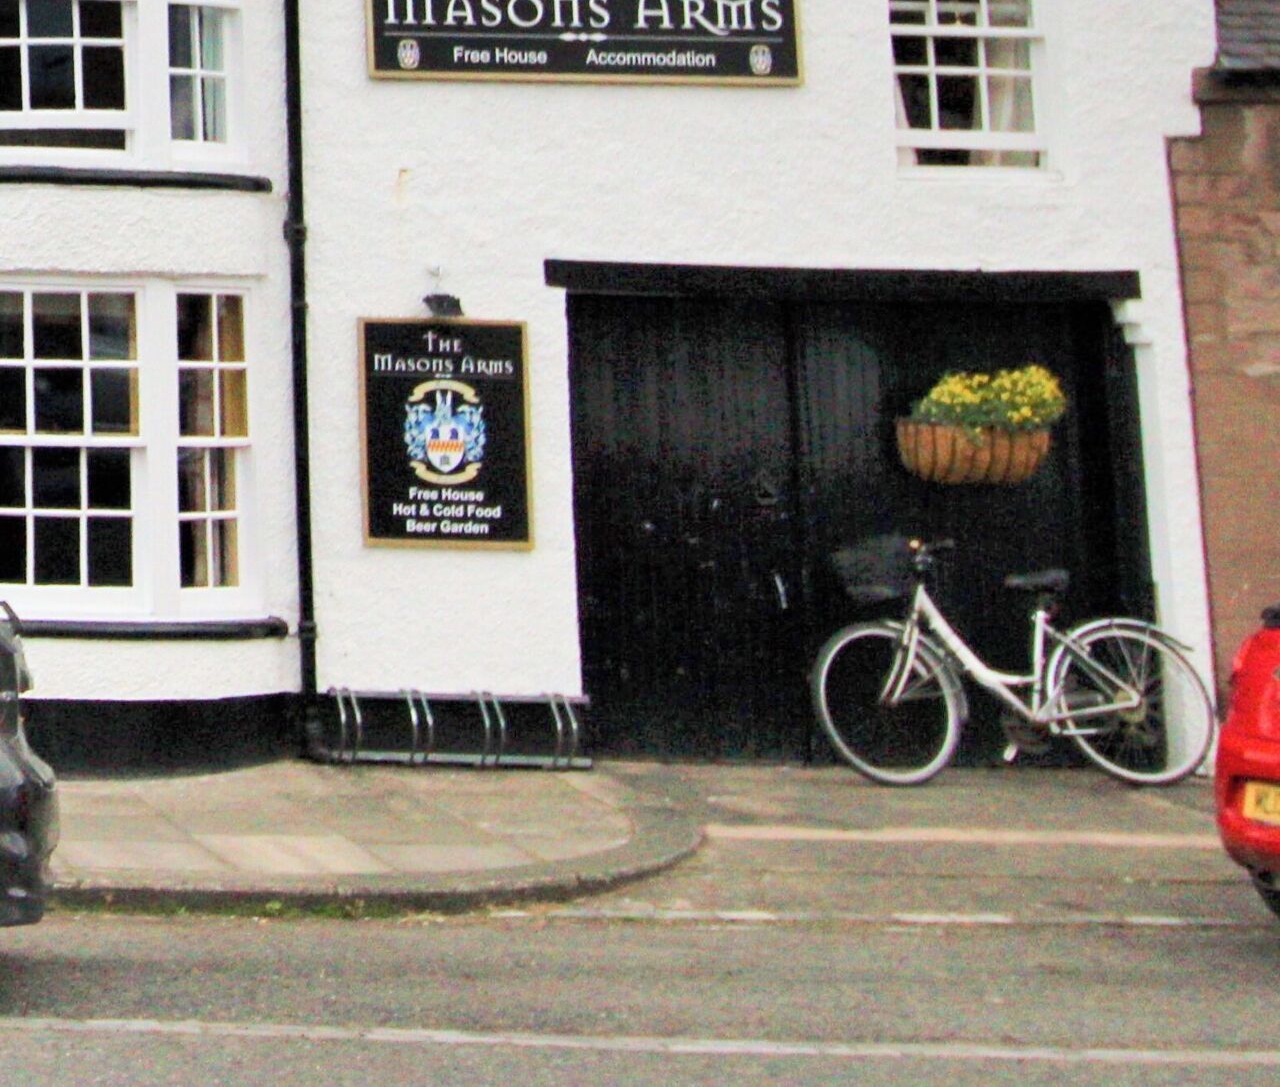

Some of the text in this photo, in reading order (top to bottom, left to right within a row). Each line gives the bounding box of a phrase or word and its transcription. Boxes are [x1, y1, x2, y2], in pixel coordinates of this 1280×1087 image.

[452, 45, 716, 67] Free House Accommodation
[422, 330, 463, 353] THE
[373, 353, 515, 375] MASONS ARMS
[408, 486, 485, 502] Free House
[392, 502, 502, 519] Hot & Cold Food
[406, 518, 490, 534] Beer Garden
